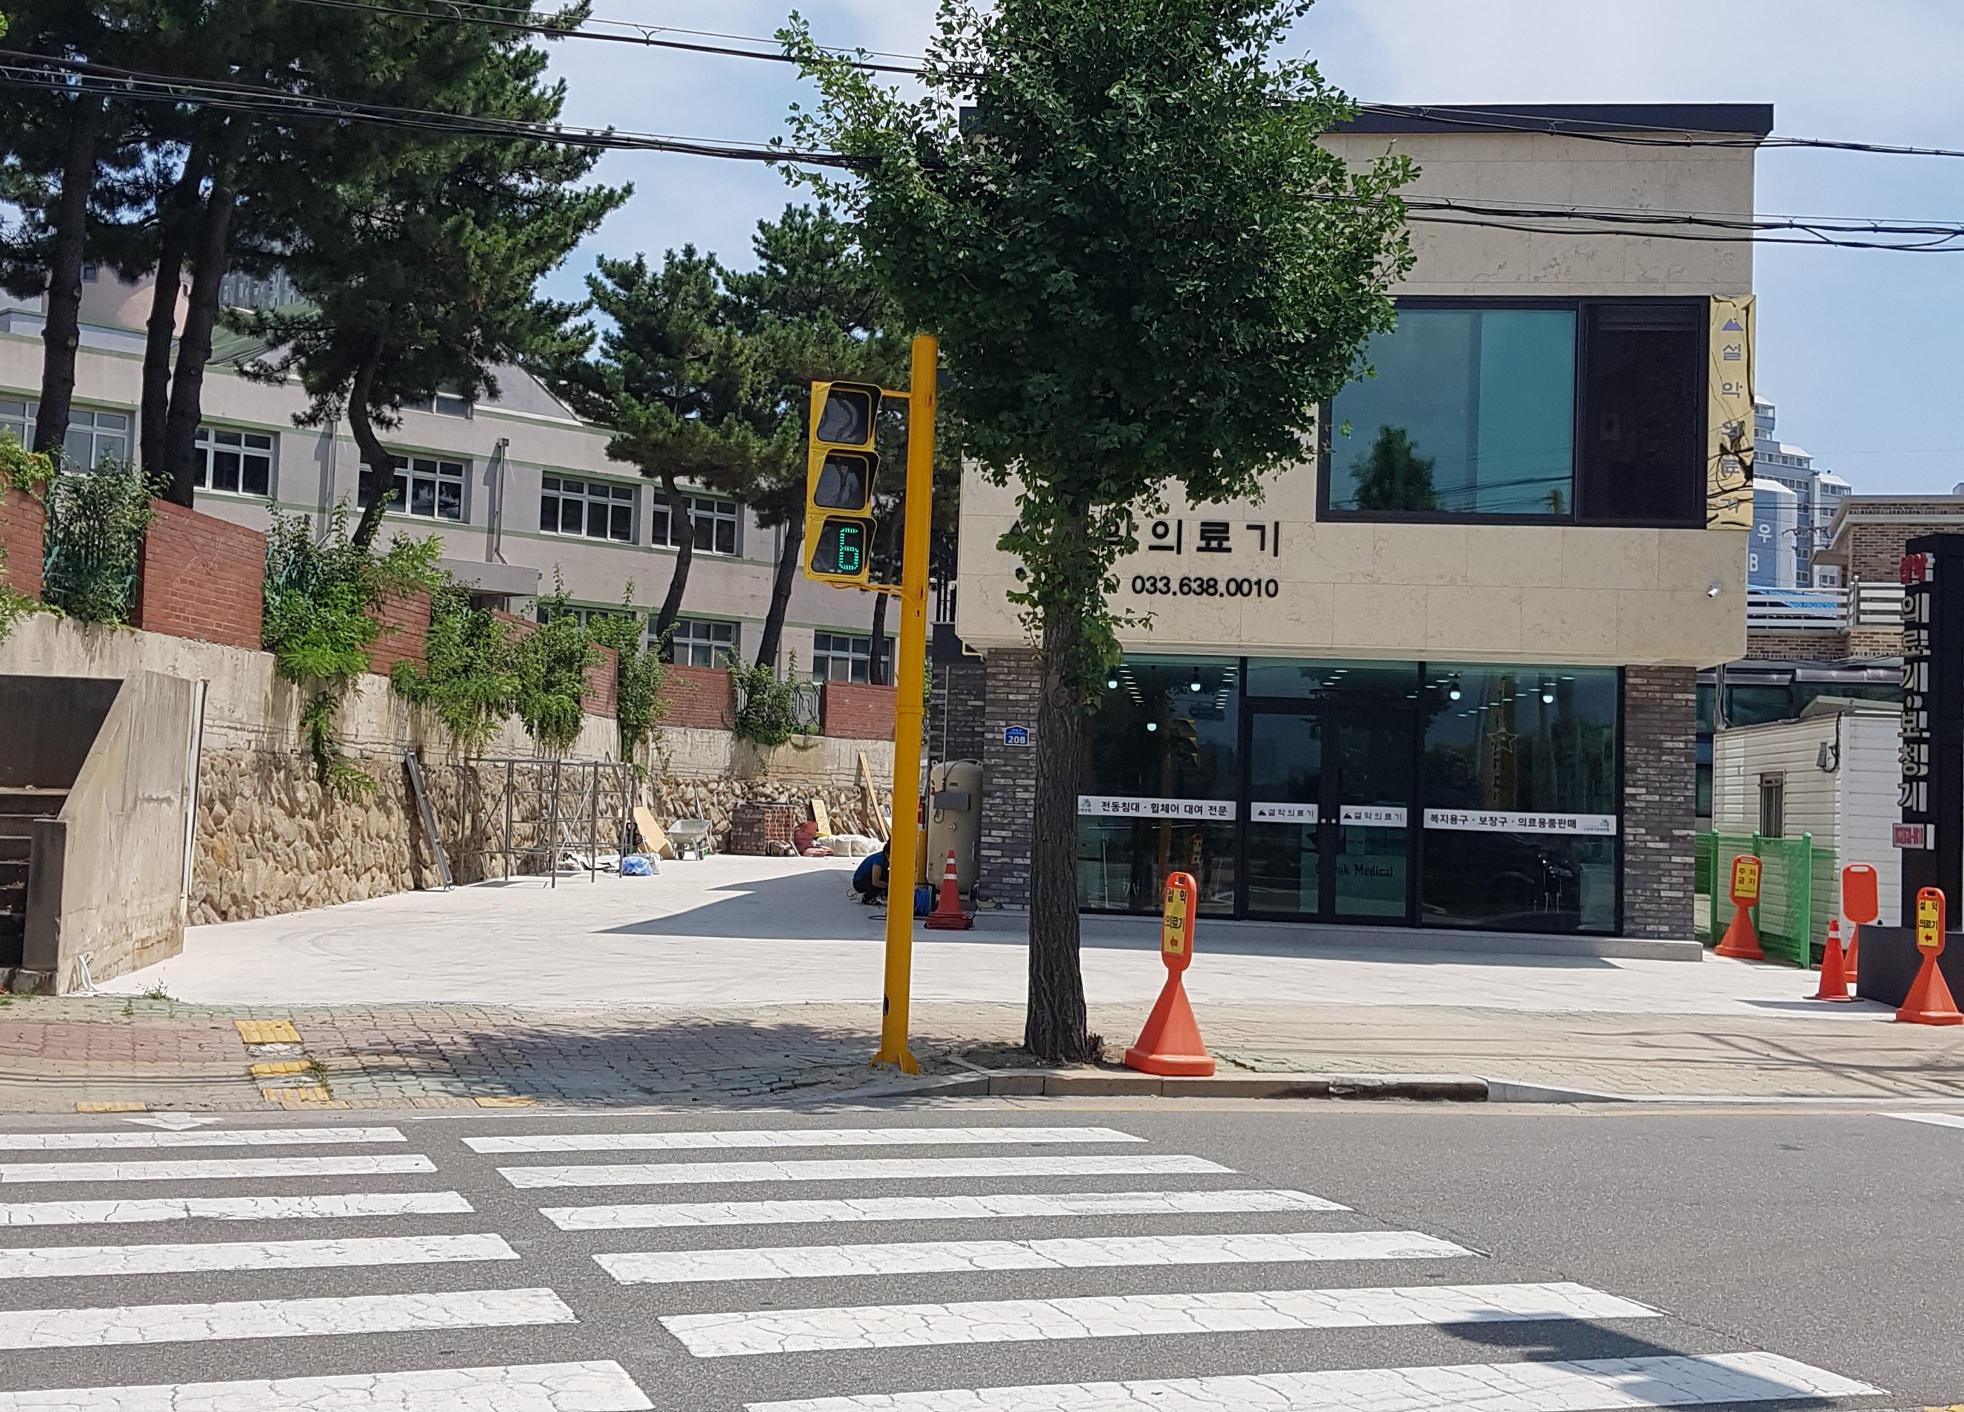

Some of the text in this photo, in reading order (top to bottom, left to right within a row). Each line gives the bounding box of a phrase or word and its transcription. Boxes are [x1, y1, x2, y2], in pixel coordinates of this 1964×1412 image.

[838, 527, 860, 571] 6
[1131, 575, 1279, 598] 033.638.0010
[1101, 801, 1140, 813] 전동침대
[1184, 804, 1204, 815] 대여
[1430, 813, 1469, 826] 복지용구
[1478, 815, 1508, 828] 보장구
